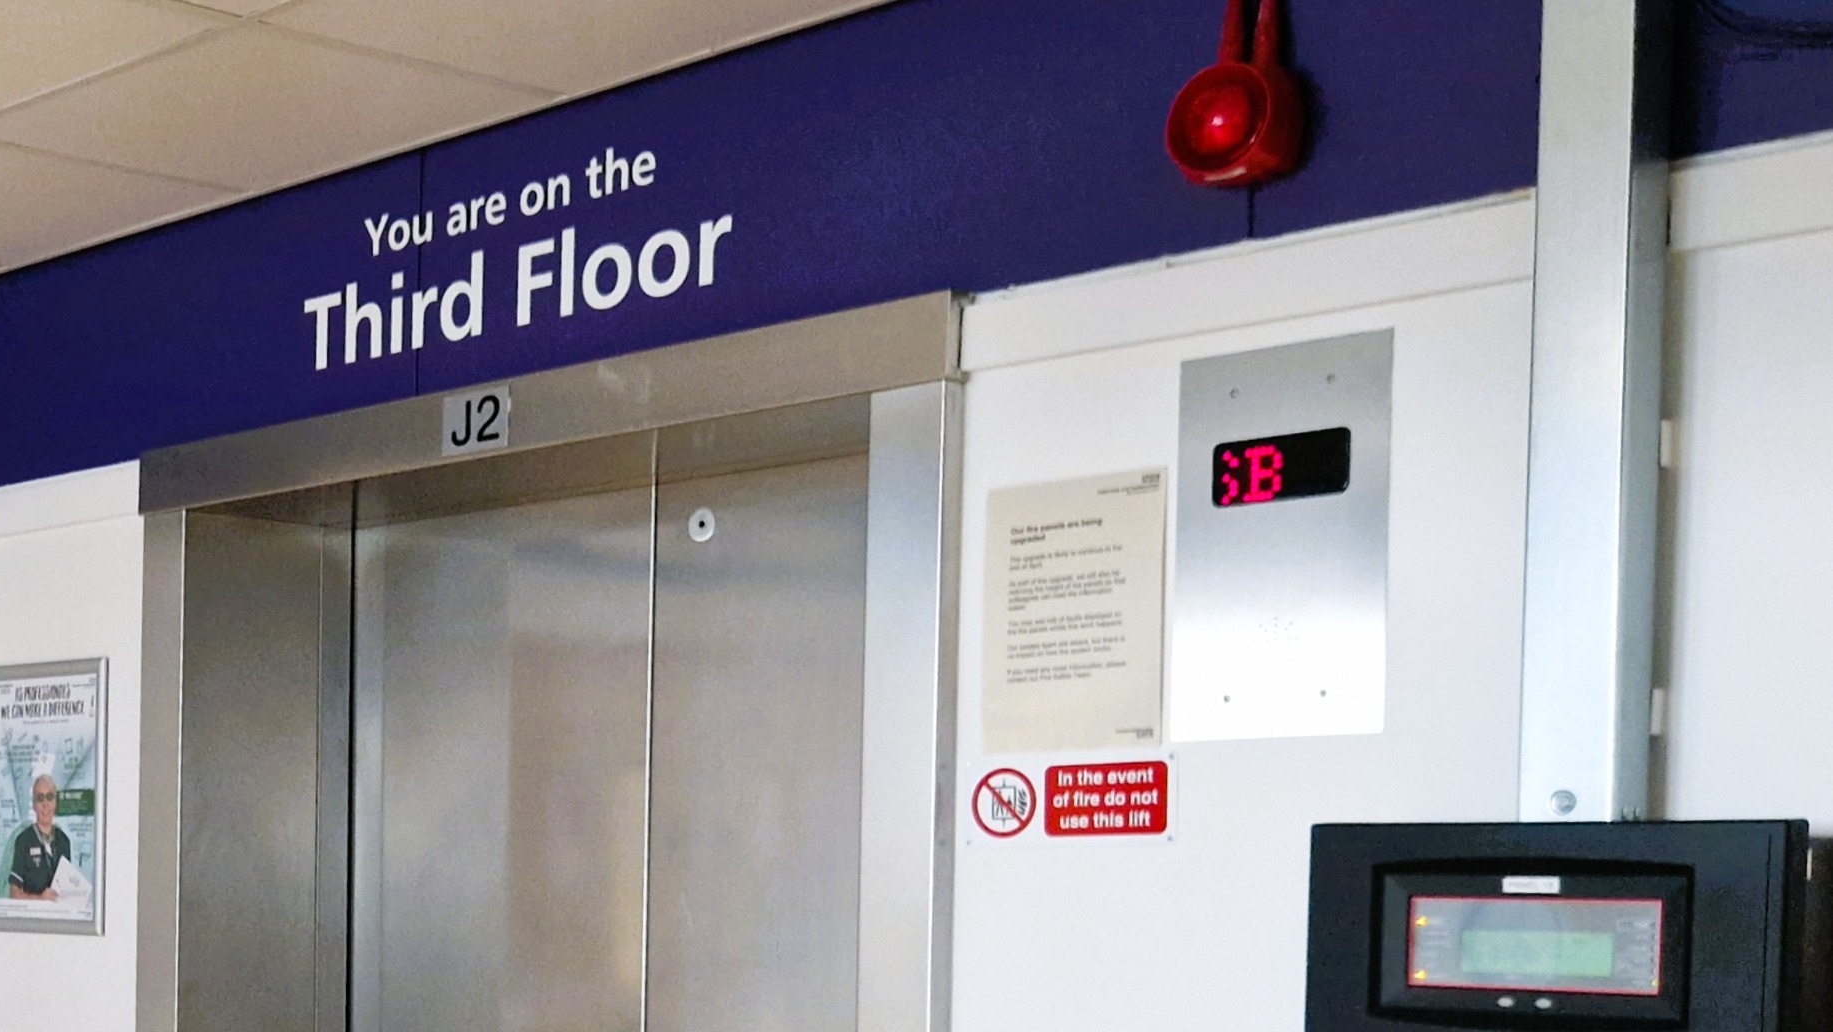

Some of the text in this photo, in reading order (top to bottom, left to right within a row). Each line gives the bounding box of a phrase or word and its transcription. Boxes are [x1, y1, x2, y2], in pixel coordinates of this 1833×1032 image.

[364, 147, 657, 257] You are on the
[303, 214, 733, 371] Third Floor
[451, 394, 501, 447] J2
[1058, 767, 1154, 787] In the event
[1053, 789, 1158, 808] of fire do not
[1060, 810, 1151, 829] use this lift
